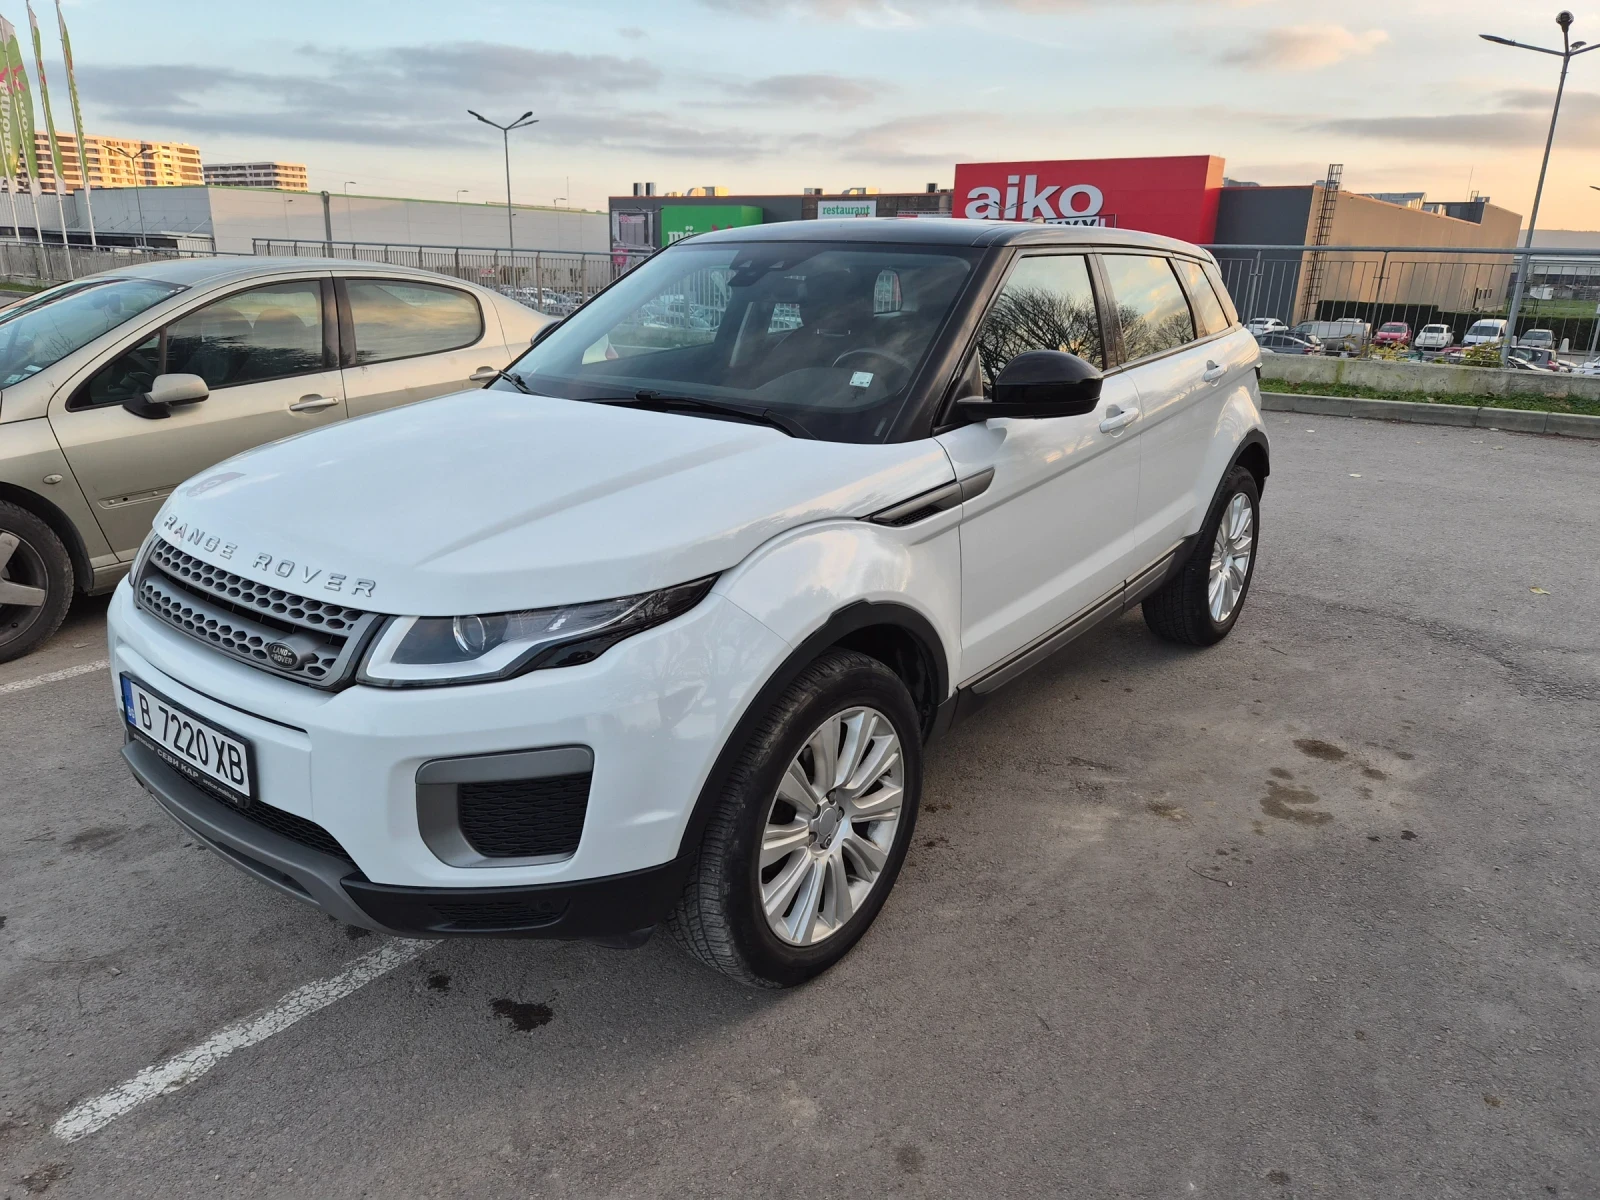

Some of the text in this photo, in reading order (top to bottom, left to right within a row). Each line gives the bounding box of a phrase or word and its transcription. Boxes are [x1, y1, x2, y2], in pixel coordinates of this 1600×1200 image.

[822, 205, 871, 215] restaurant
[964, 174, 1104, 219] aiko
[164, 514, 377, 597] RANGE ROVER
[272, 646, 289, 657] LAND
[273, 654, 293, 665] ROVER
[138, 692, 245, 786] B 7220 XB
[156, 747, 199, 779] СЕВИ КАР
